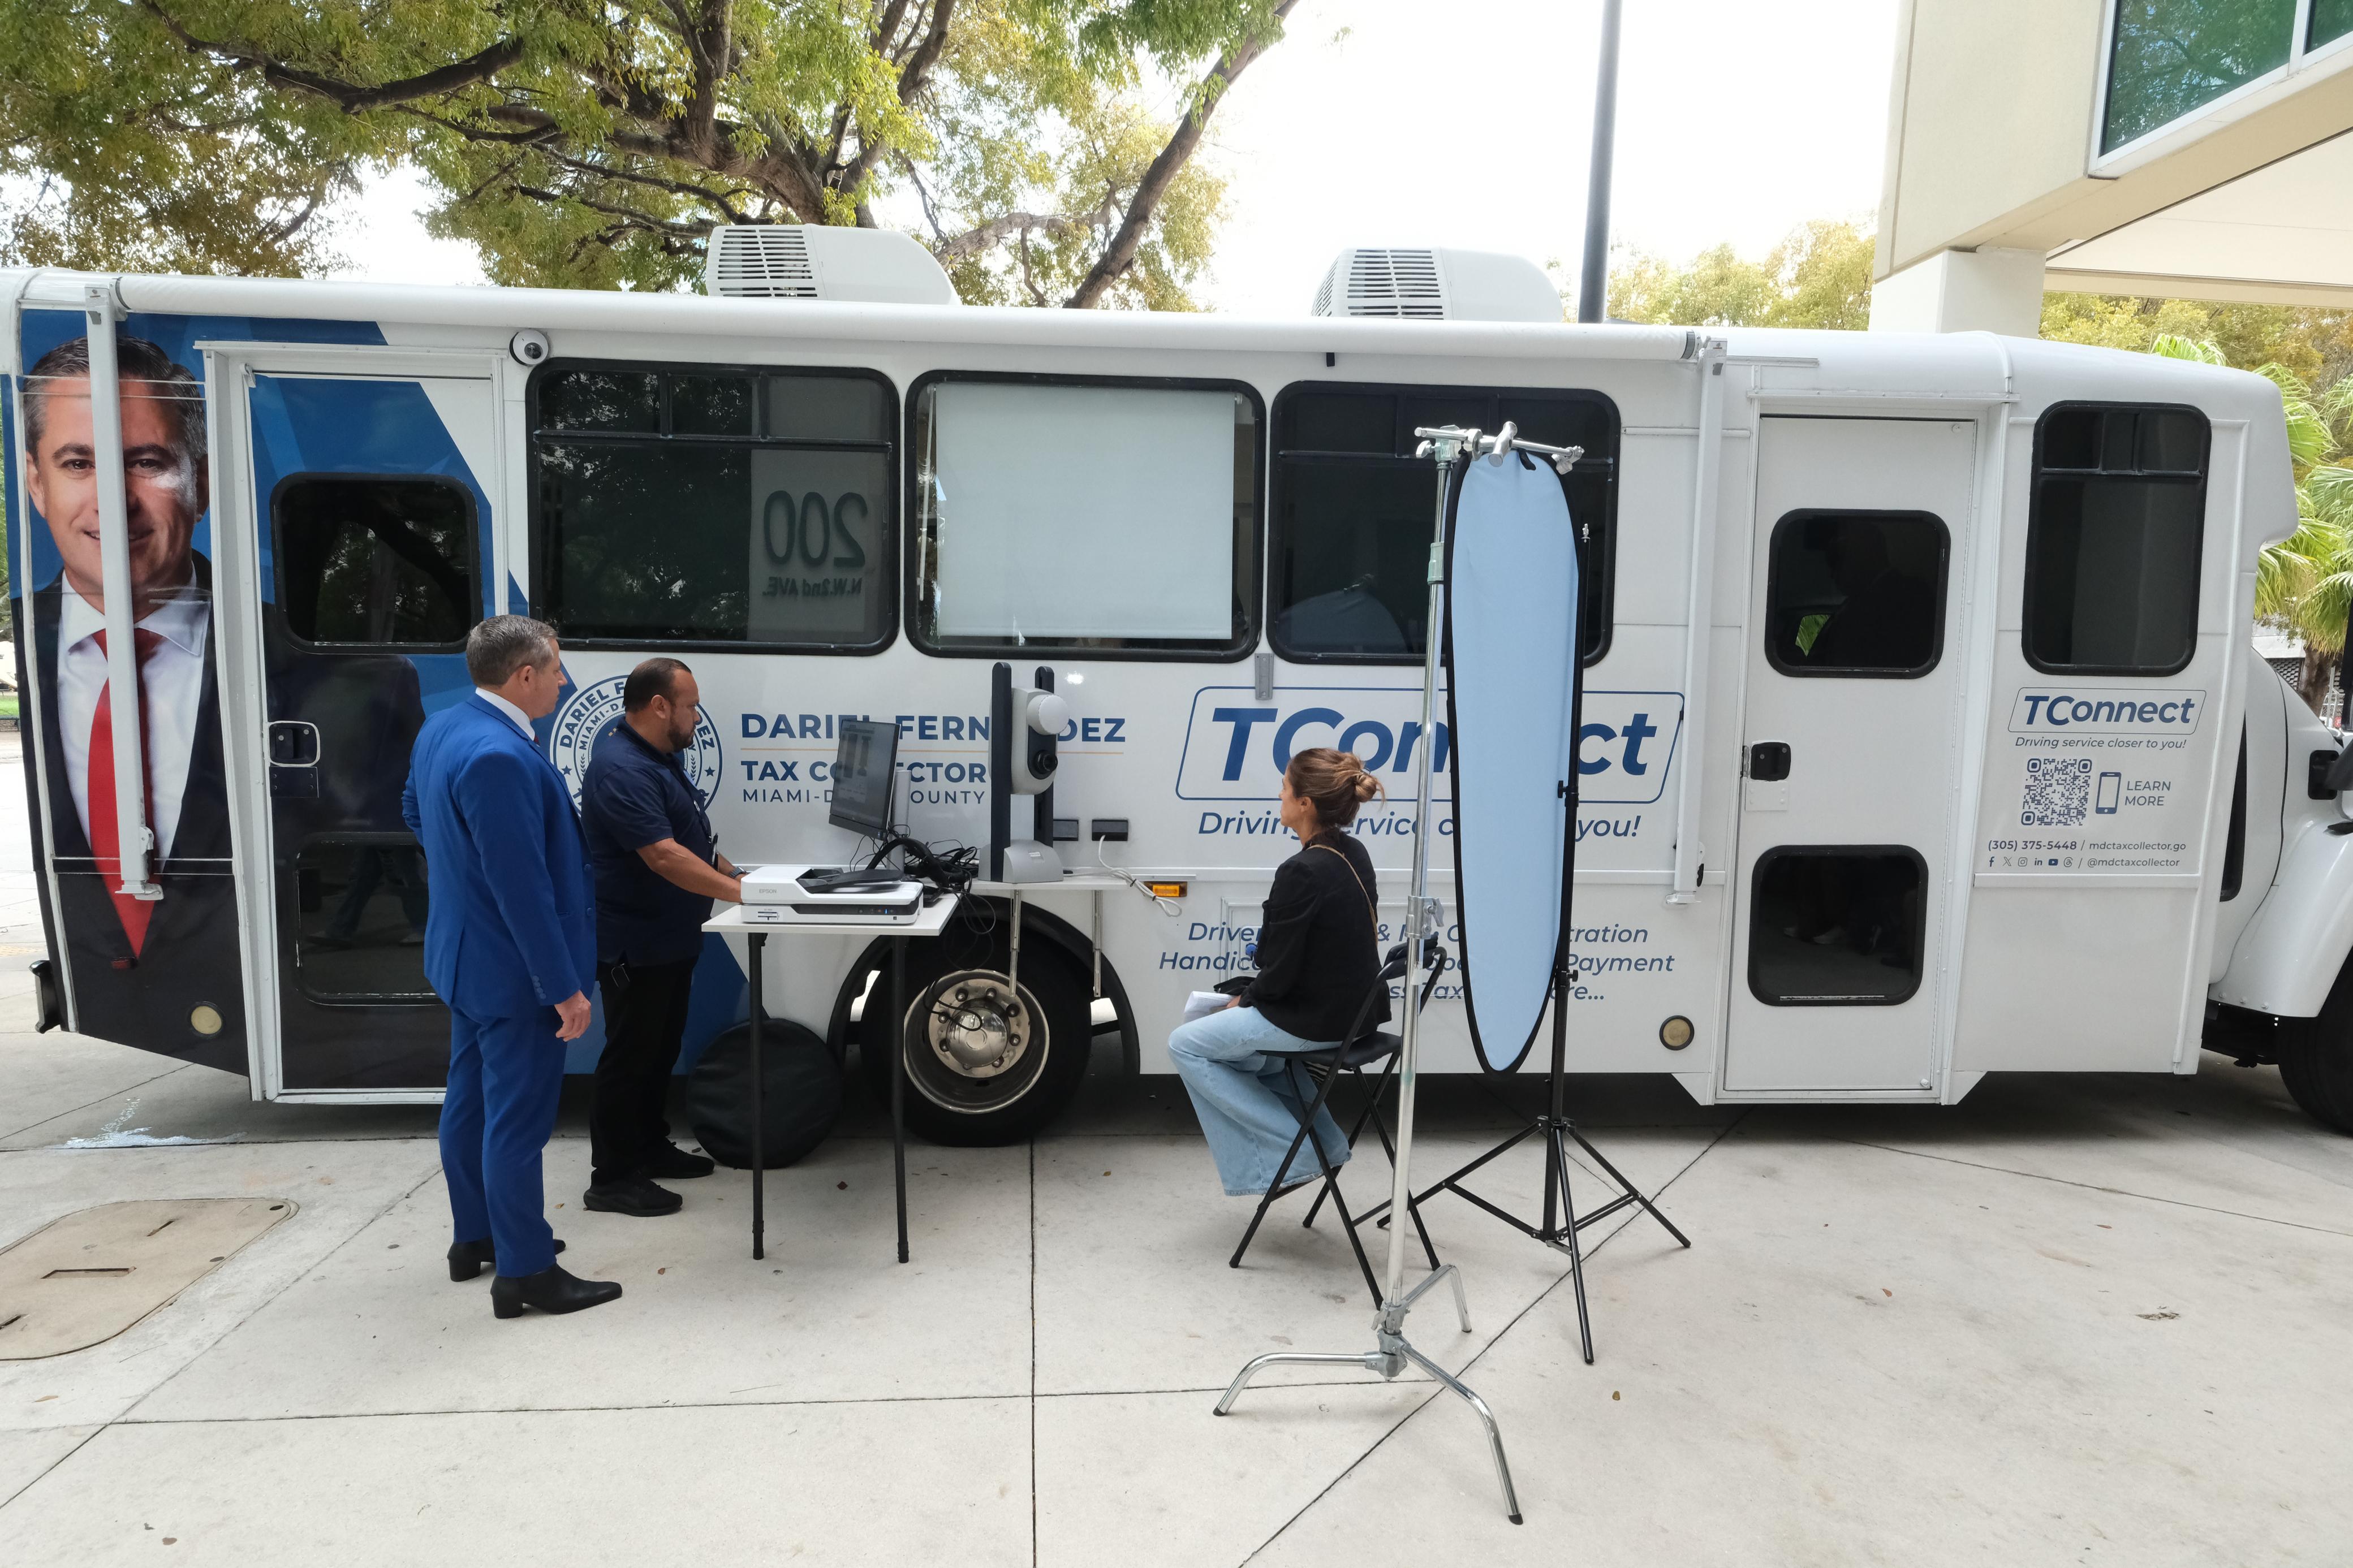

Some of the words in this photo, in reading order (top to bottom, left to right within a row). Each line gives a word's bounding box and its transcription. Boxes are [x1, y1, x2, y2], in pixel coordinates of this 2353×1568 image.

[560, 689, 610, 748] DARIEL
[2024, 696, 2195, 725] TConnect
[579, 703, 625, 750] MIAMI-D
[741, 714, 869, 739] DARI
[1212, 707, 1657, 781] TConct
[2015, 737, 2059, 749] Driving
[2062, 737, 2104, 748] service
[2108, 738, 2143, 749] closer
[2146, 740, 2158, 749] to
[2160, 739, 2187, 750] you!
[741, 761, 799, 781] TAX
[2127, 781, 2171, 791] LEARN
[910, 790, 985, 804] OUNTY
[2124, 796, 2165, 806] MORE
[1575, 815, 1641, 842] you!
[1988, 840, 2018, 852] (305)
[2022, 841, 2077, 850] 375-5448
[2089, 841, 2186, 852] mdctaxcollector.go
[2087, 858, 2180, 868] @mdctaxcollector
